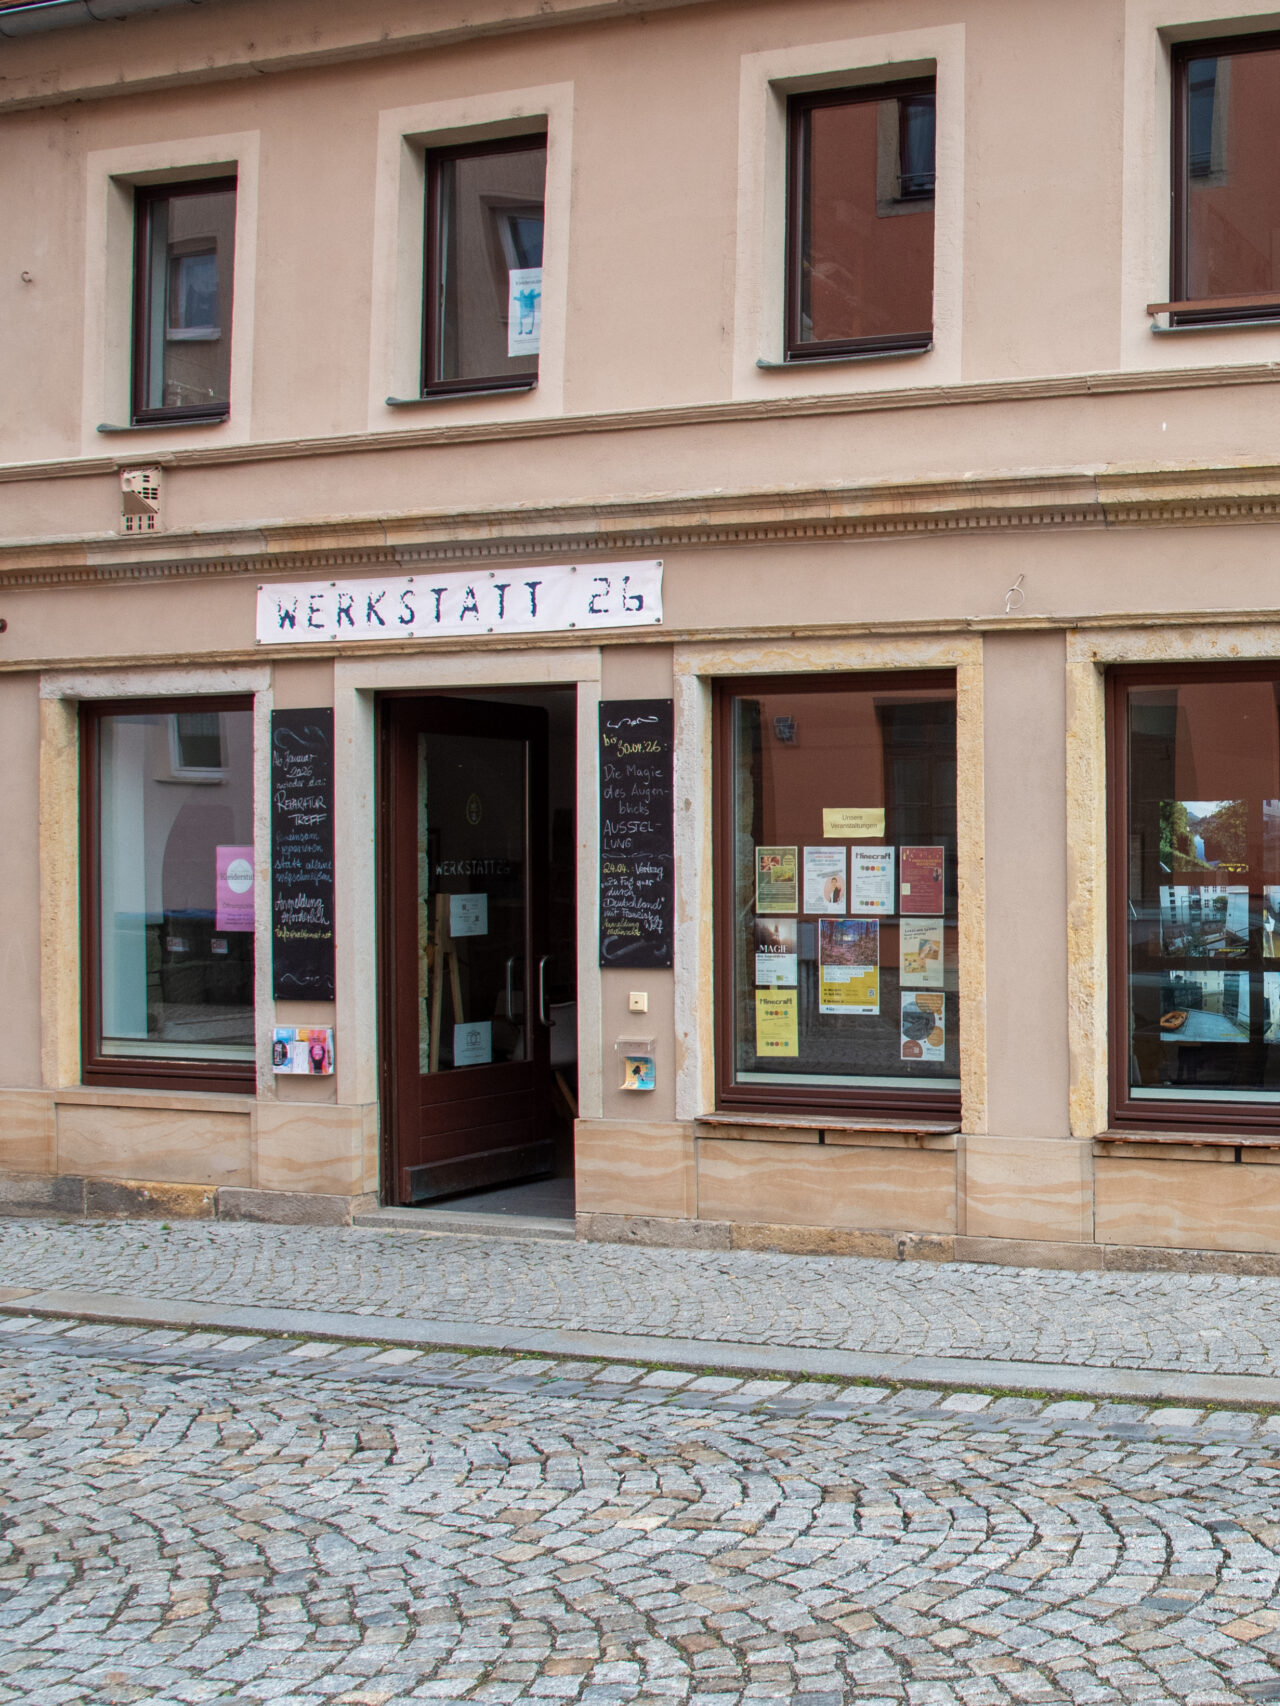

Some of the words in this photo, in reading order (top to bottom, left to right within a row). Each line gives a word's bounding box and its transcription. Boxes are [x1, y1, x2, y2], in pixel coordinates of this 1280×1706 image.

[277, 581, 543, 630] WERKSTATT
[588, 576, 644, 615] 26
[604, 764, 622, 781] Die
[626, 765, 664, 785] Magie
[604, 784, 626, 799] des
[619, 800, 650, 815] blicks
[830, 822, 878, 831] Veranstaltungen
[603, 838, 632, 850] LUNG
[436, 860, 495, 876] WERKSTATT
